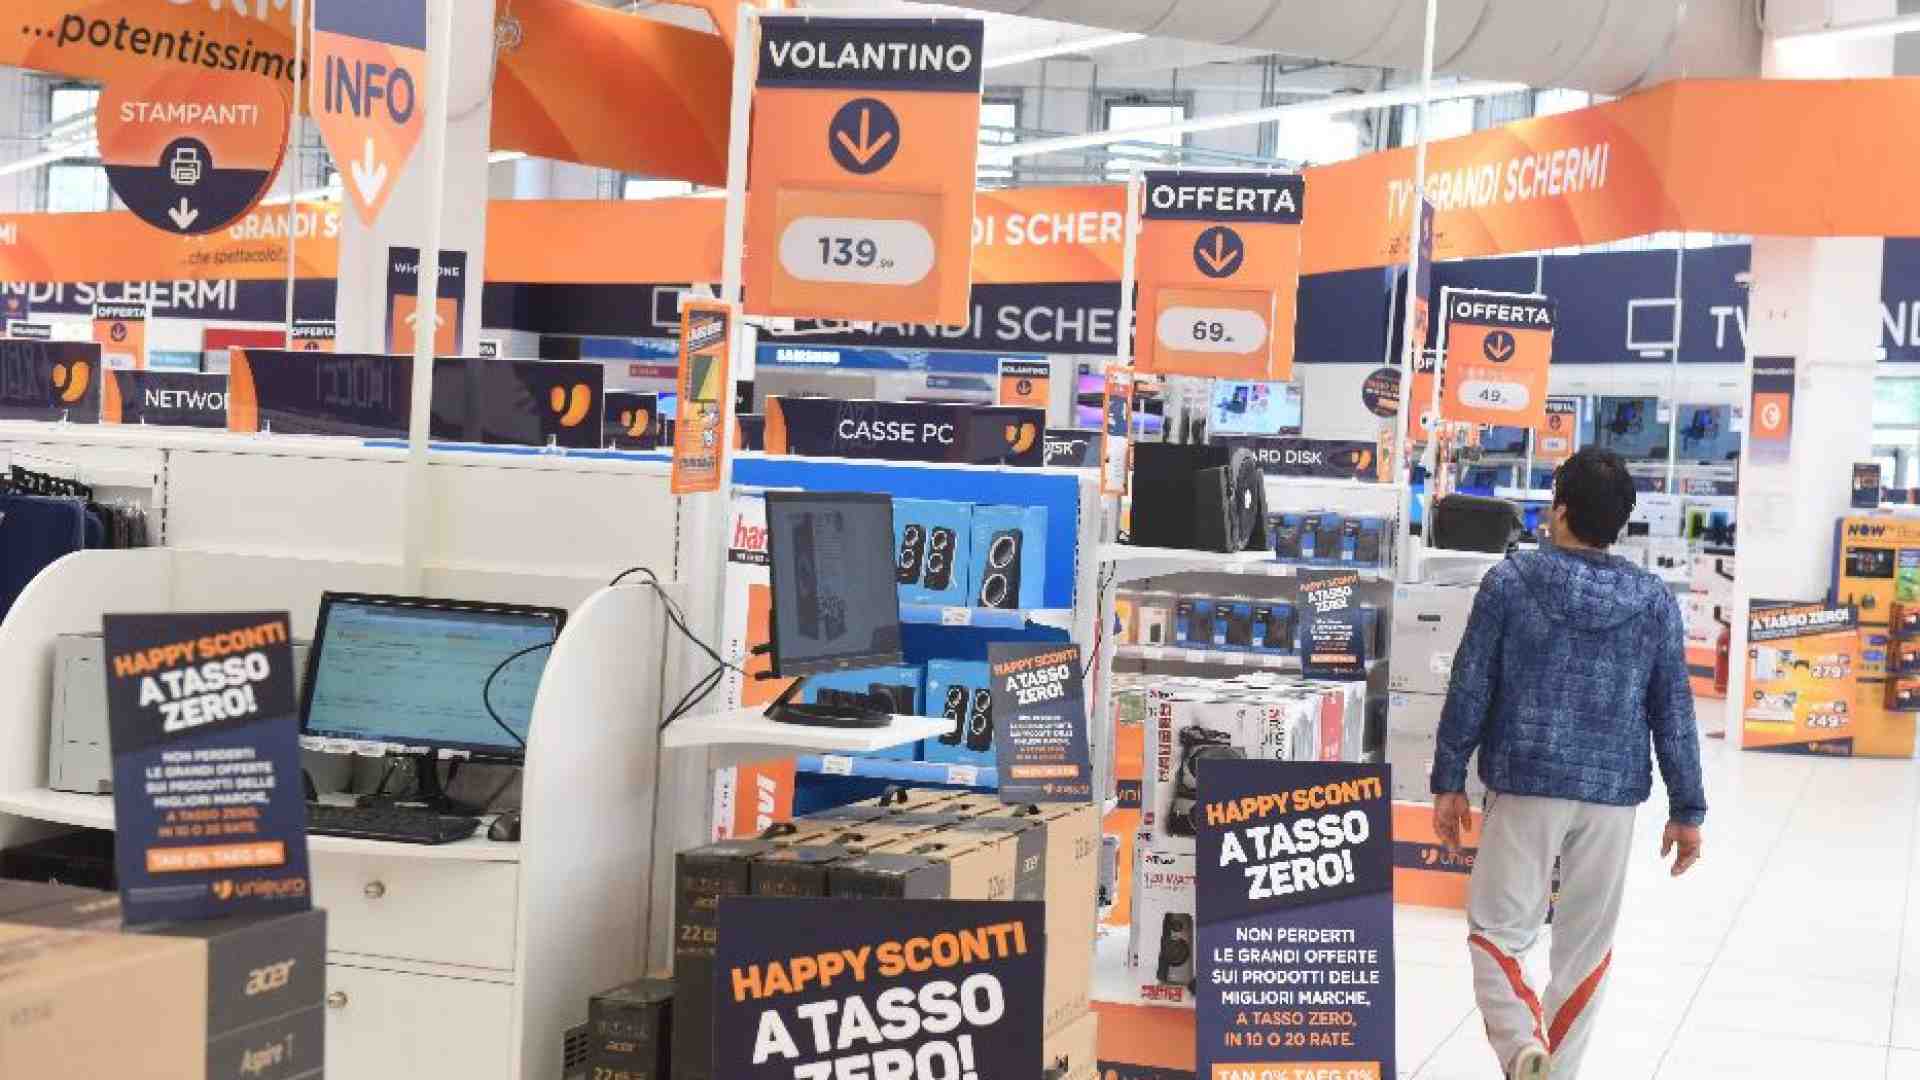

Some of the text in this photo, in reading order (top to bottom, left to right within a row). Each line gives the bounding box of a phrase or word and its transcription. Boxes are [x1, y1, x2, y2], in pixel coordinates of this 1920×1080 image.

[22, 14, 308, 84] ...potentissimo
[769, 40, 972, 73] VOLANTINO
[324, 55, 415, 125] INFO
[119, 101, 258, 126] STAMPANTI
[1504, 142, 1610, 205] SCHERMI
[1152, 184, 1296, 213] OFFERTA
[1005, 212, 1123, 246] SCHER
[996, 306, 1121, 343] SCHE
[1456, 302, 1550, 323] OFFERTA
[839, 419, 953, 443] CASSE PC
[1285, 450, 1322, 465] DISK
[113, 622, 287, 676] HAPPY SCONTI
[139, 652, 270, 706] A TASSO
[159, 686, 258, 732] ZERO!
[1207, 777, 1382, 825] HAPPY SCONTI
[1219, 810, 1368, 866] A TASSO
[1245, 849, 1354, 900] ZERO!
[1236, 928, 1355, 943] NON PERDERTI
[732, 921, 1027, 1003] HAPPY SCONTI
[1214, 948, 1377, 963] LE GRANDI OFFERTE
[1212, 969, 1379, 984] SUI PRODOTTI DELLE
[1222, 990, 1371, 1006] MIGLIORI MARCHE,
[753, 972, 1005, 1064] A TASSO
[1236, 1011, 1248, 1025] A
[1253, 1011, 1303, 1025] TASSO
[1225, 1031, 1242, 1046] IN
[1246, 1032, 1262, 1046] 10
[1285, 1032, 1305, 1046] 20
[1310, 1031, 1354, 1046] RATE.
[794, 1034, 978, 1080] ZERO!
